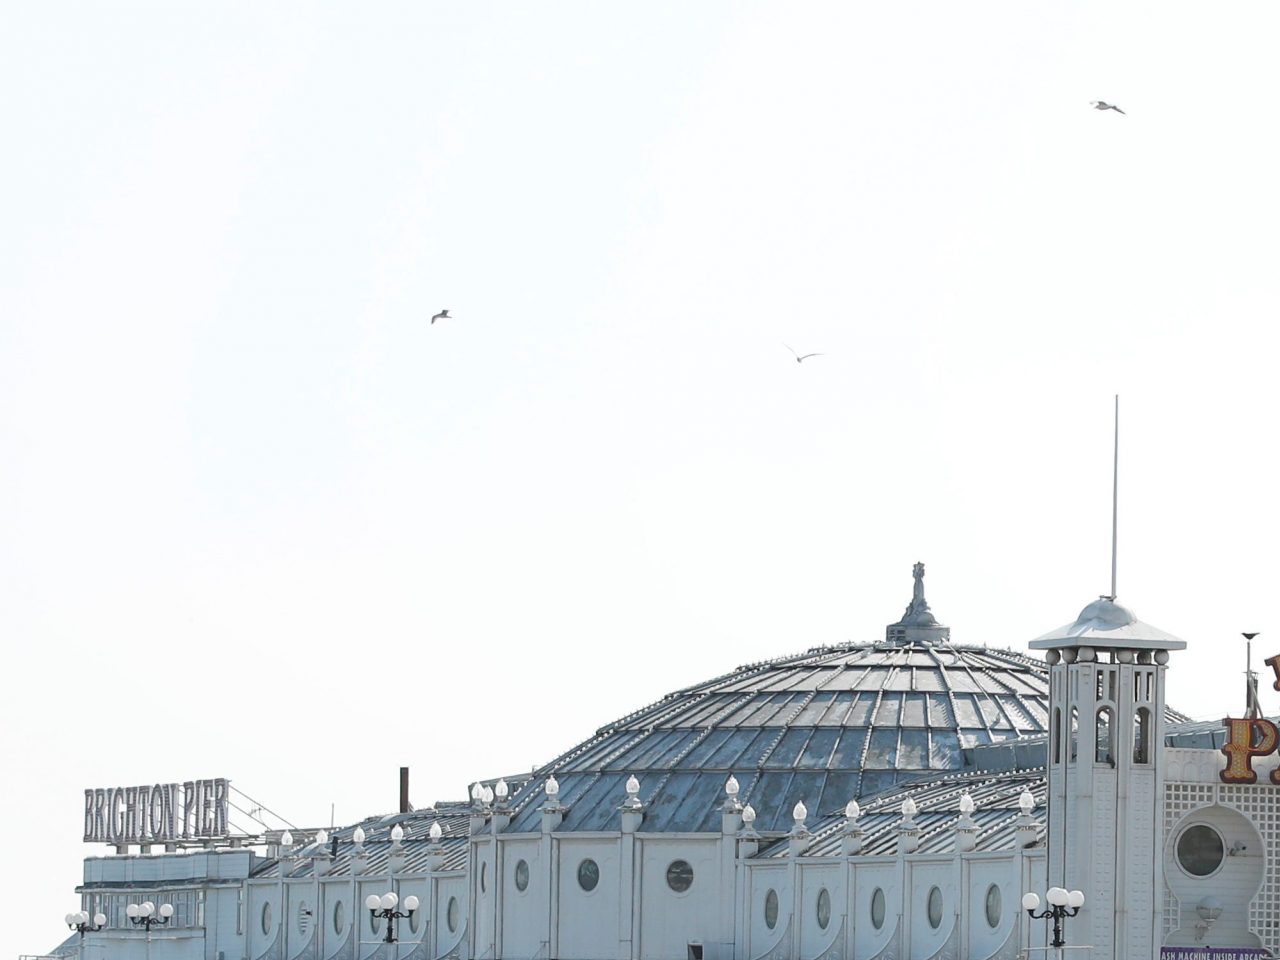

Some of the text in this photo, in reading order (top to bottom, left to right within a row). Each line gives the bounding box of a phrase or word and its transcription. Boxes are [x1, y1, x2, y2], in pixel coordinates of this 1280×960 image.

[83, 778, 229, 843] BRIGHTON PIER
[1161, 952, 1176, 960] ASH
